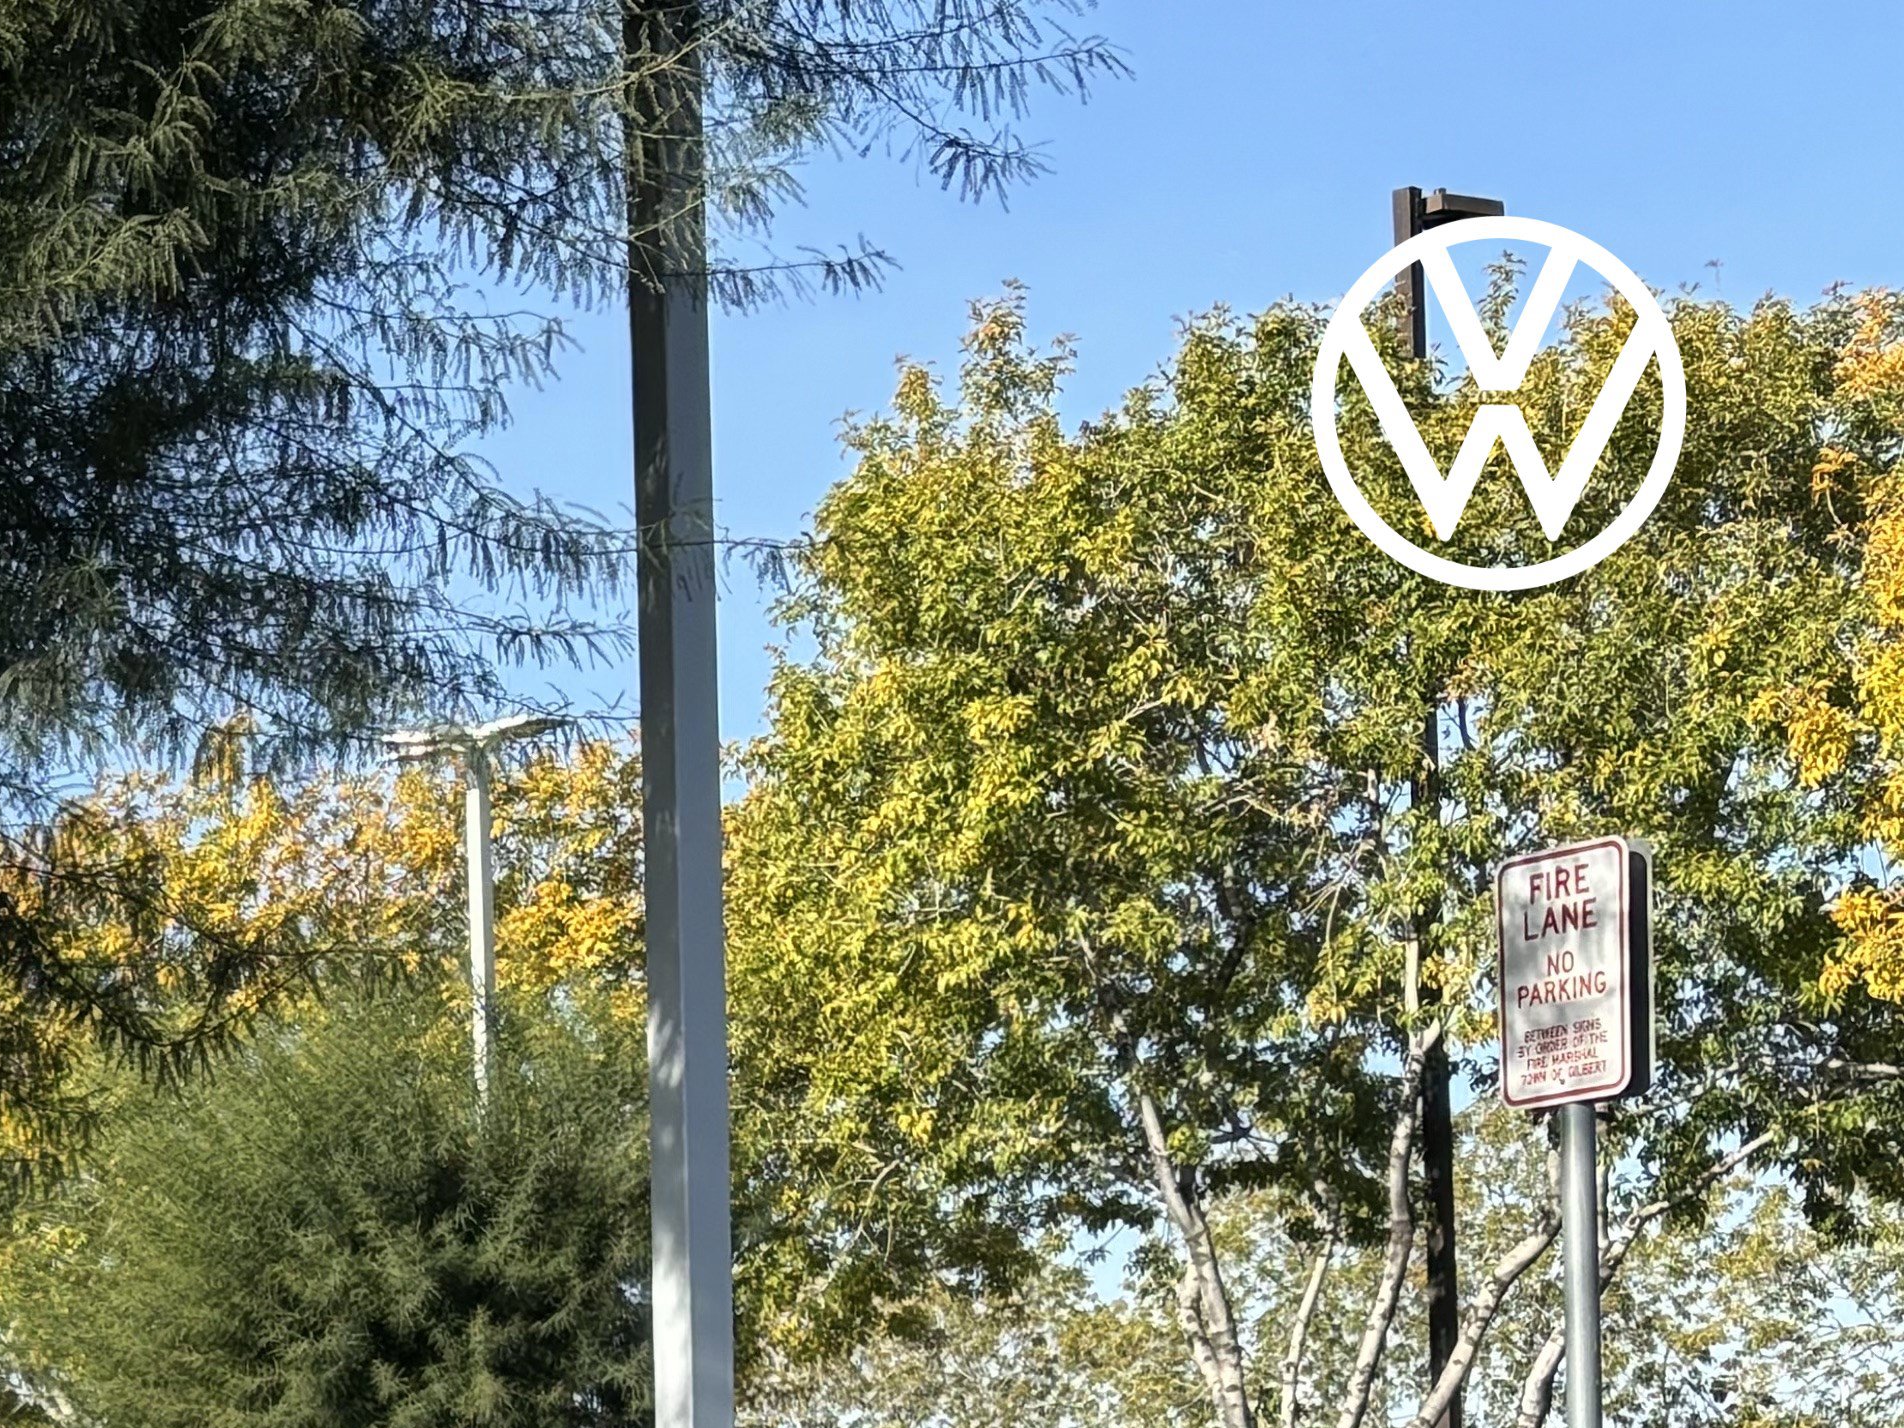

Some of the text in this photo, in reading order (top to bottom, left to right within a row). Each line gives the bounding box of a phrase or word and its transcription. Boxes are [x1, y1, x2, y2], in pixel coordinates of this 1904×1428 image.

[1529, 863, 1590, 905] FIRE
[1524, 897, 1598, 942] LANE
[1547, 951, 1575, 977] NO
[1517, 970, 1607, 1009] PARKING
[1589, 1030, 1608, 1044] THE
